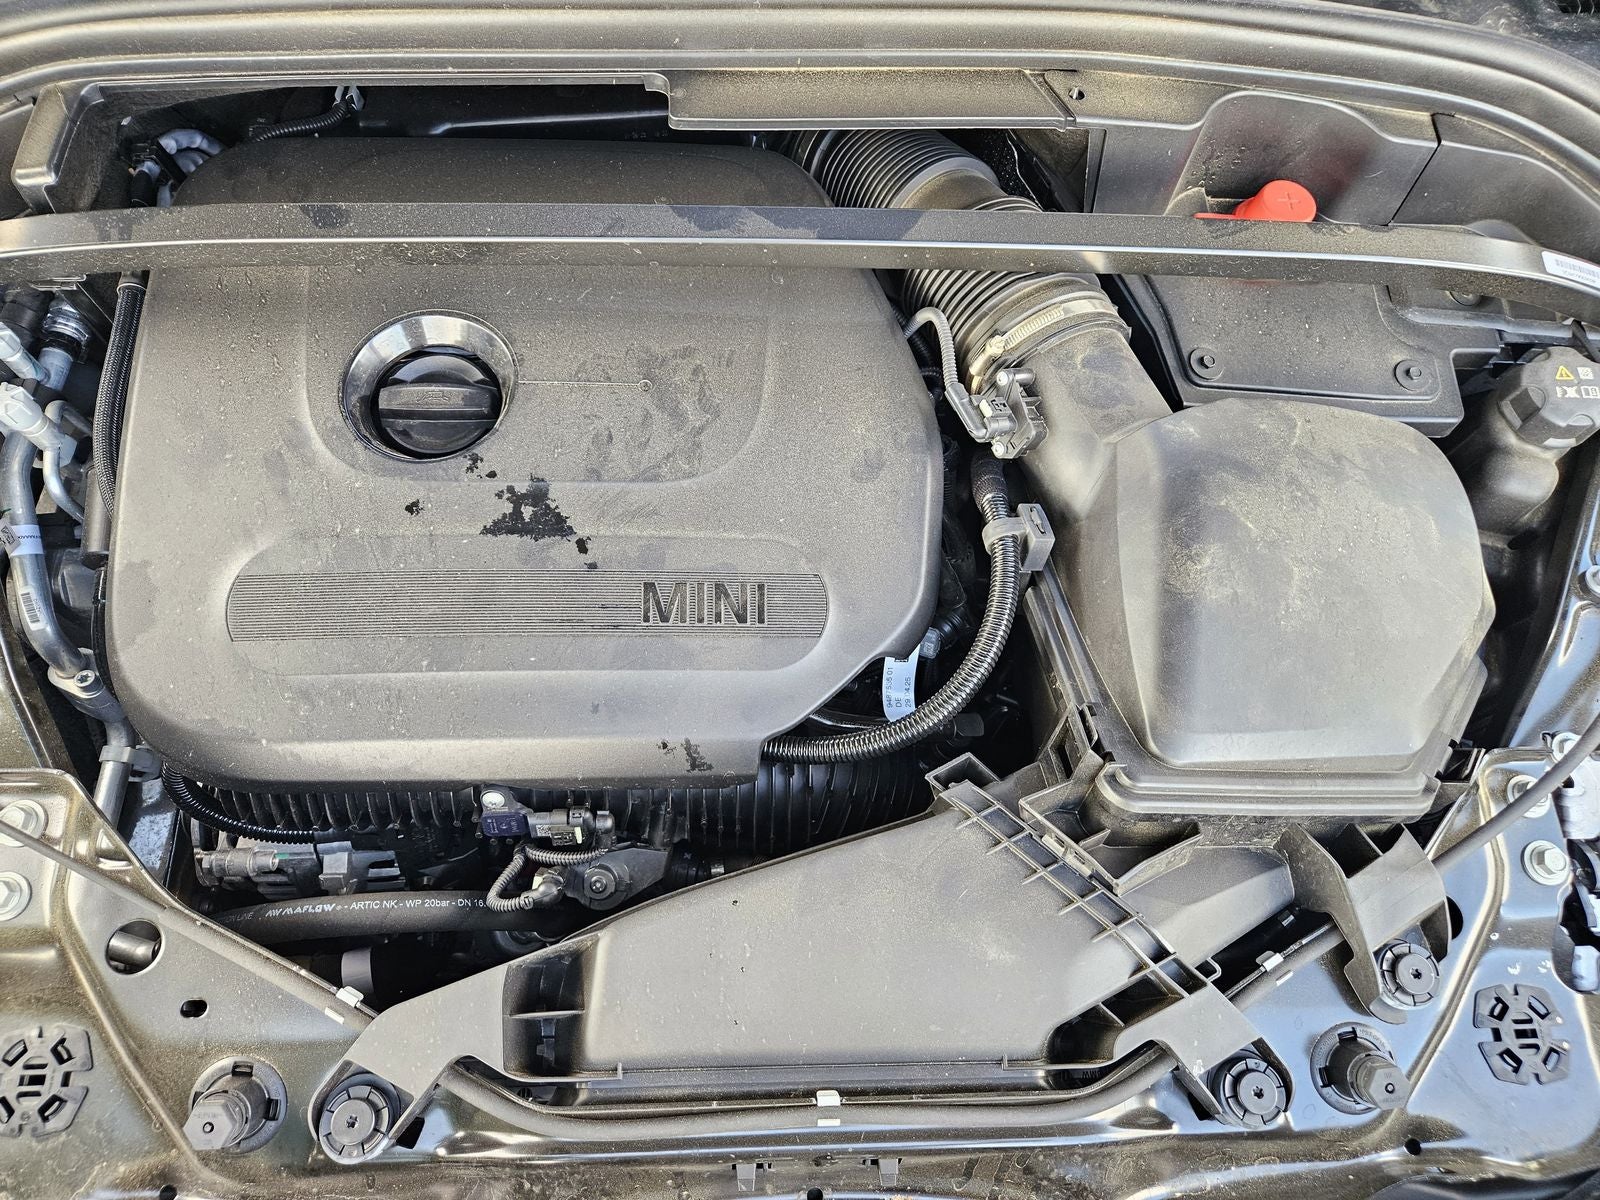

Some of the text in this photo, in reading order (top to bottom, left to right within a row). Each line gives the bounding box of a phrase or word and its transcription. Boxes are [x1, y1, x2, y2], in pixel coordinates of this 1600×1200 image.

[642, 581, 766, 624] MINI
[895, 697, 902, 708] DE
[350, 901, 380, 910] ARTIC
[382, 900, 398, 909] NK
[405, 899, 422, 908] WP
[424, 899, 450, 907] 20bar
[457, 898, 472, 907] DN
